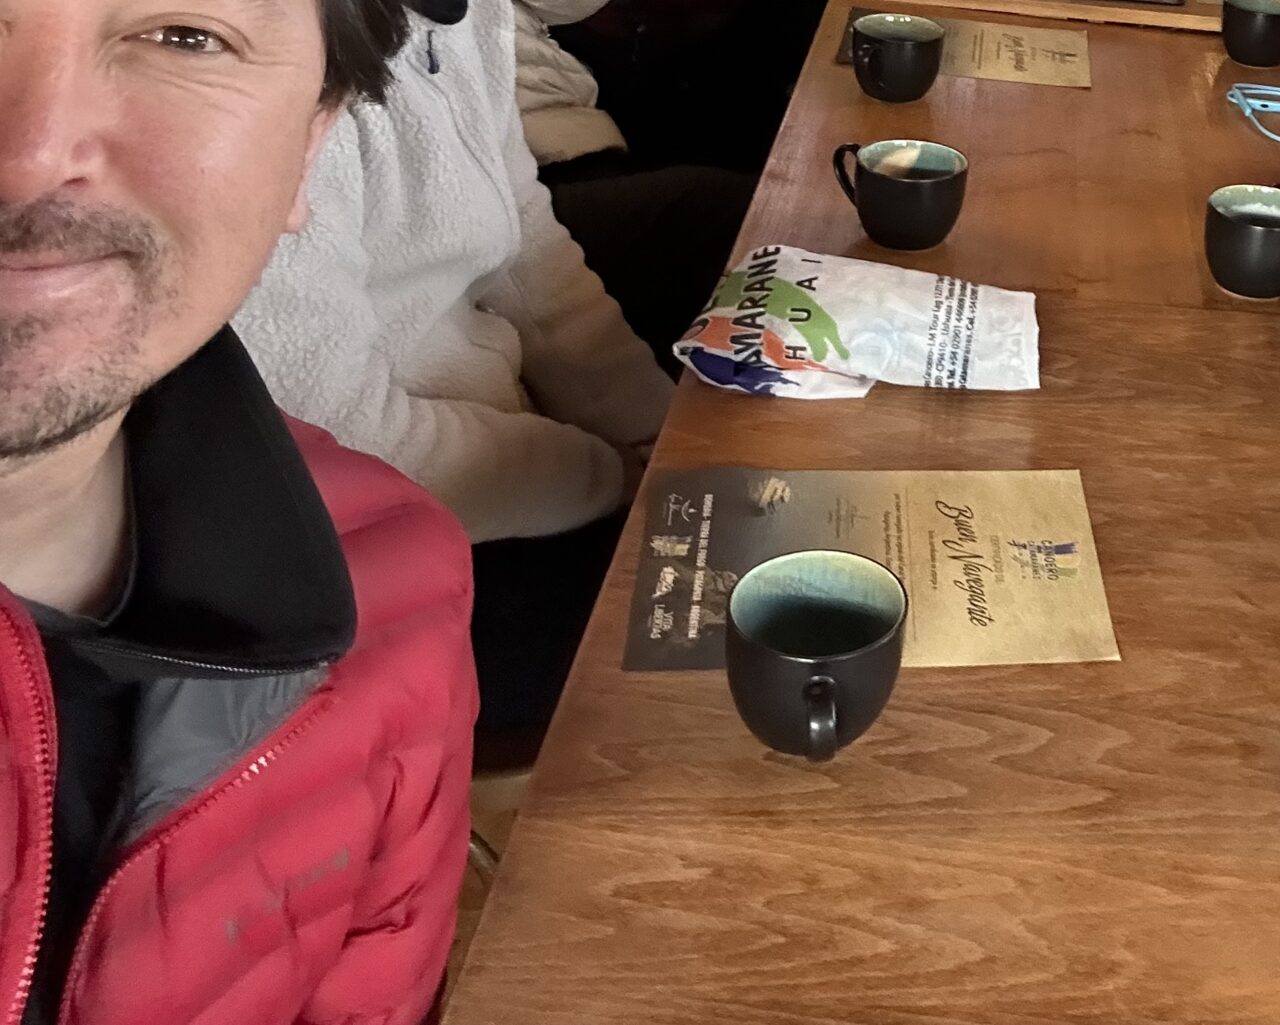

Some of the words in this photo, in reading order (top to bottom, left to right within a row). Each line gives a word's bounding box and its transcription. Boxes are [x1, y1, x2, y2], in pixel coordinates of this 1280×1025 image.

[935, 500, 977, 542] Buen
[1041, 540, 1059, 581] CANOERO
[942, 540, 995, 628] Navegante
